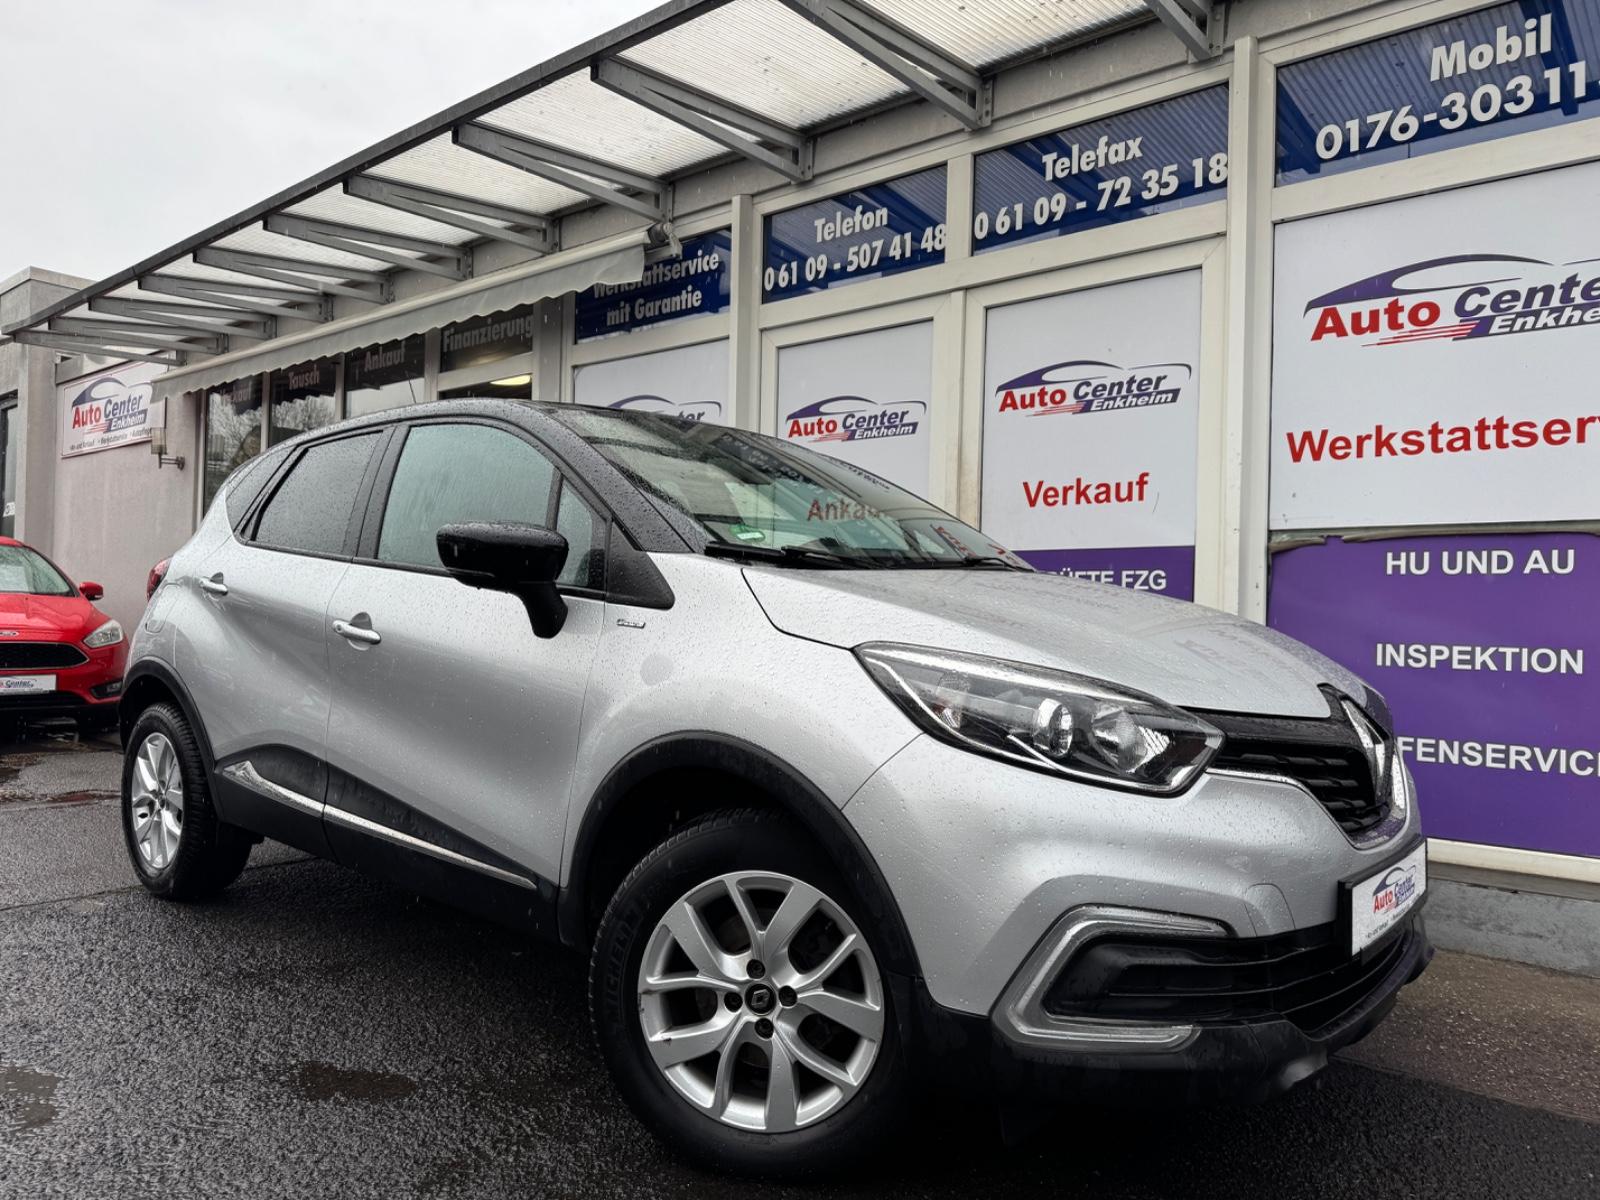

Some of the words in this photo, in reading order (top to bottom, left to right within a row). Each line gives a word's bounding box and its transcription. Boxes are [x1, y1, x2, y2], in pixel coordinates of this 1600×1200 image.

[1430, 12, 1552, 82] Mobil
[1315, 61, 1600, 160] 0176-30311
[1042, 135, 1143, 181] Telefax
[1033, 193, 1067, 226] 09
[1097, 176, 1131, 211] 72
[1141, 164, 1179, 200] 35
[1192, 152, 1228, 188] 18
[814, 205, 888, 243] Telefon
[805, 254, 828, 282] 09
[847, 239, 884, 272] 507
[889, 232, 912, 261] 41
[921, 223, 946, 252] 48
[606, 301, 630, 326] mit
[634, 285, 702, 320] Garantie
[1310, 297, 1441, 342] Auto
[443, 315, 533, 352] Finanzierung
[364, 341, 405, 372] Ankauf
[288, 365, 320, 390] Tausch
[999, 386, 1067, 413] Auto
[1073, 375, 1168, 401] Center
[72, 404, 101, 429] Auto
[103, 394, 142, 419] Center
[1090, 390, 1173, 412] Enkheim
[788, 417, 838, 438] Auto
[842, 409, 909, 430] Center
[854, 424, 913, 440] Enkheim
[1286, 415, 1600, 463] Werkstattser
[1022, 472, 1150, 508] Verkauf
[1121, 569, 1167, 590] FZG
[1386, 551, 1430, 575] HU
[1441, 550, 1514, 575] UND
[1523, 549, 1575, 574] AU
[1376, 643, 1583, 675] INSPEKTION
[1397, 736, 1600, 777] FENSERVIC
[1373, 889, 1393, 914] Auto
